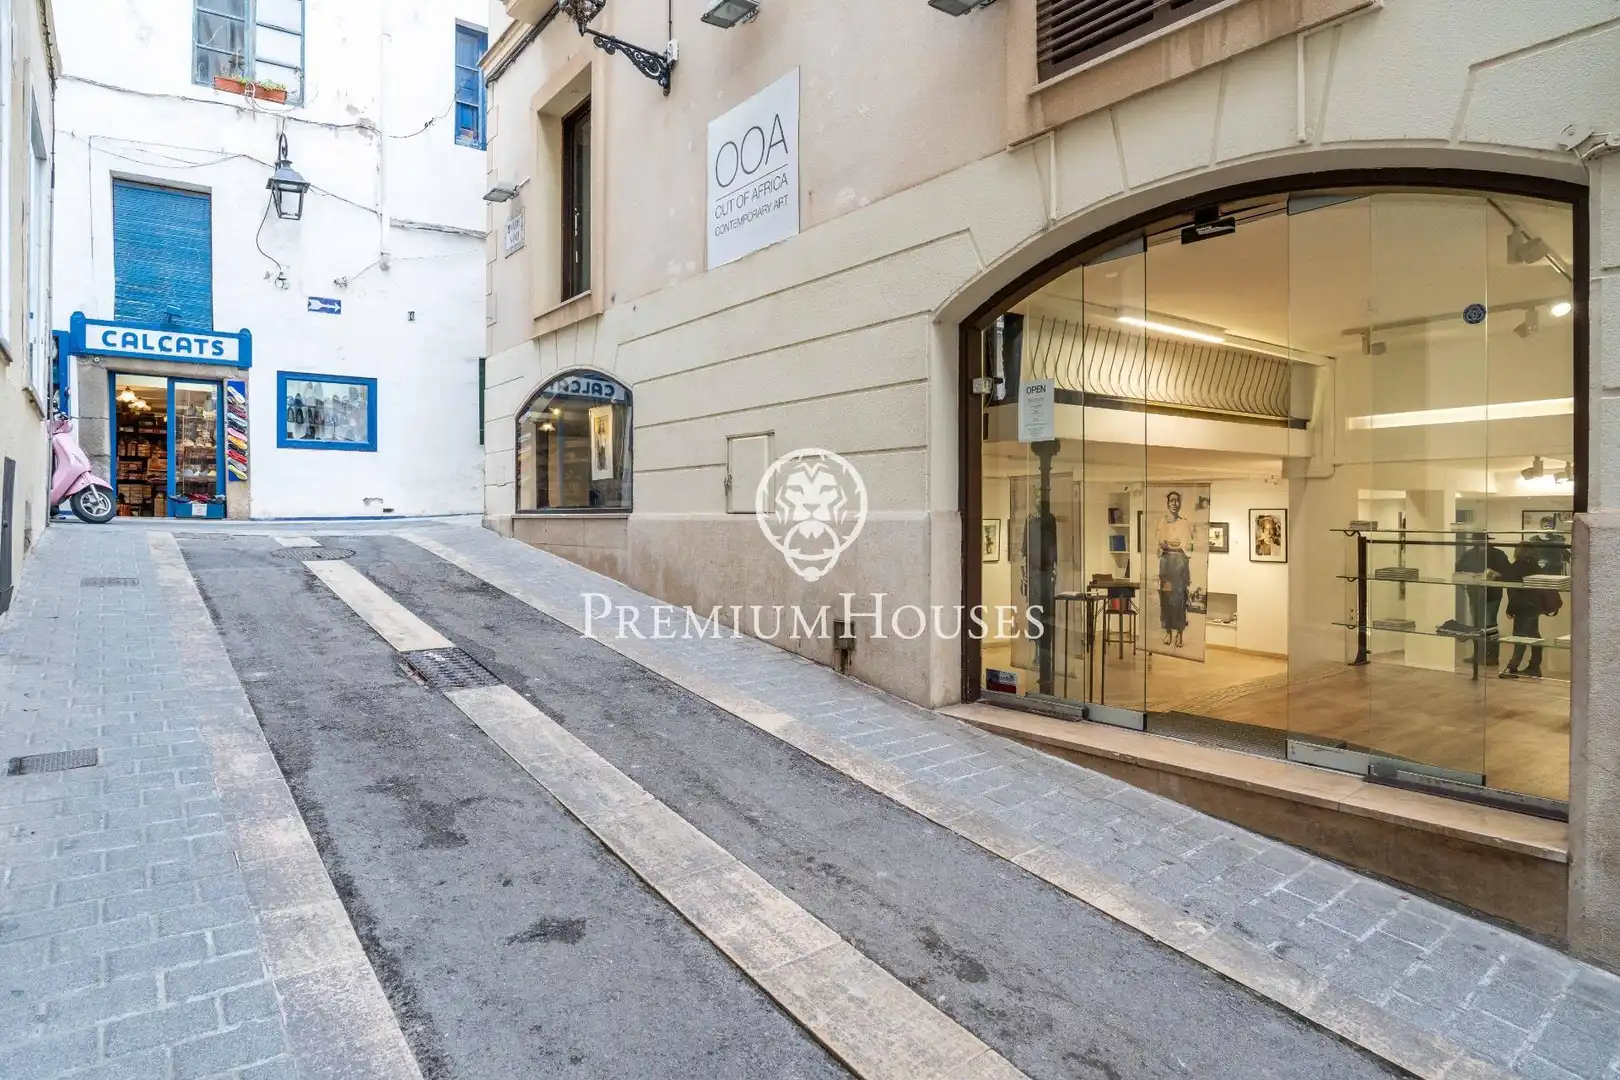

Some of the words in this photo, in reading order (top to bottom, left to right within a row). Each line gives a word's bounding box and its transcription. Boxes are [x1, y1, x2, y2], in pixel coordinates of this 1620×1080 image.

[716, 114, 788, 187] OOA
[715, 199, 734, 218] OUT
[736, 191, 749, 208] OF
[752, 173, 788, 202] AFRICA
[715, 202, 772, 236] CONTEMPORARY
[773, 194, 788, 210] ART
[1026, 385, 1046, 394] OPEN
